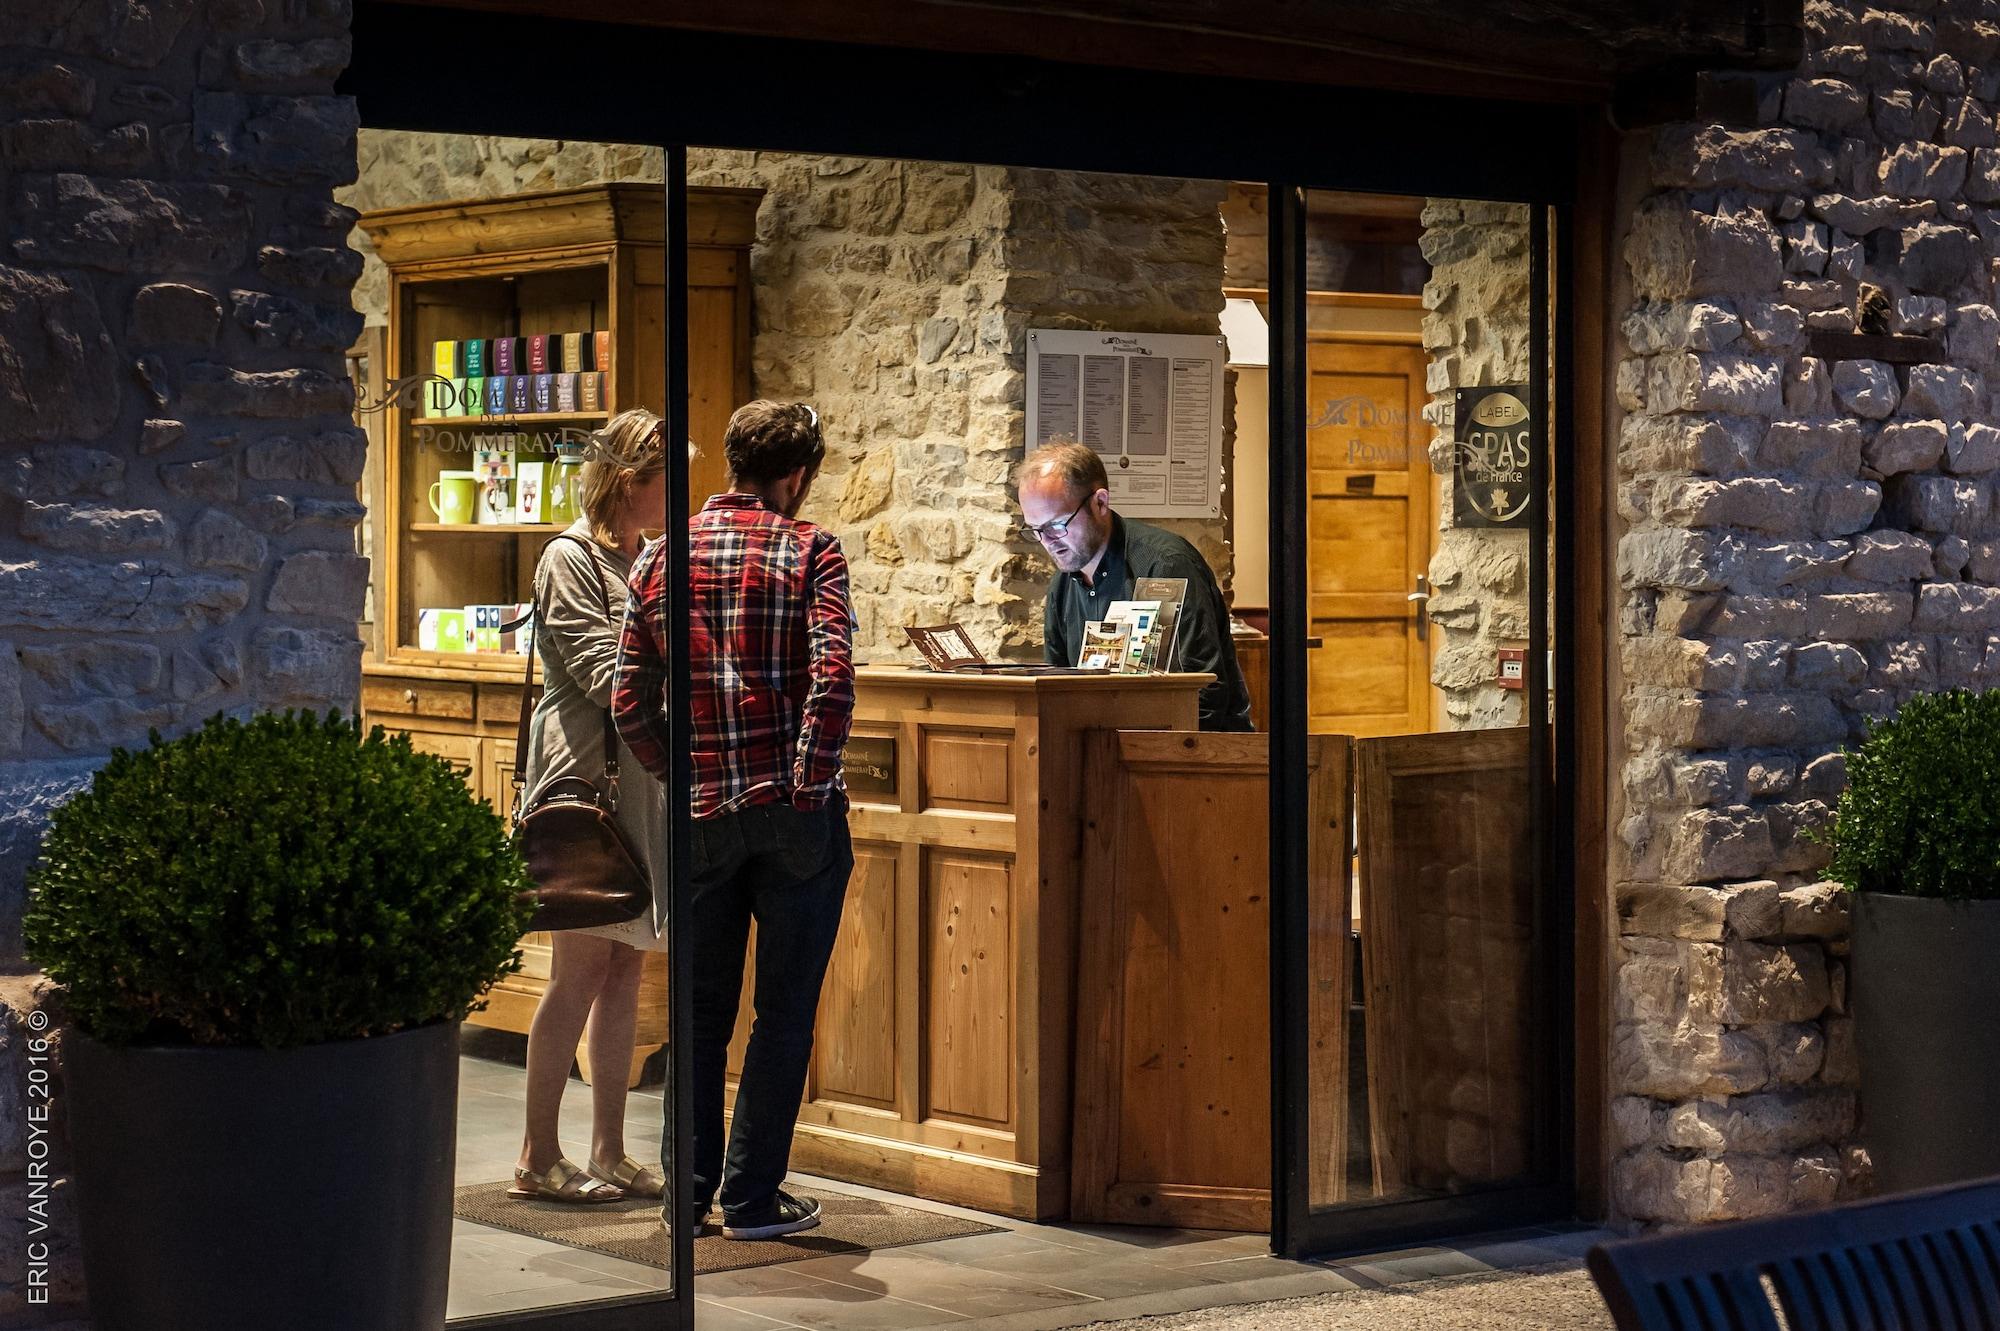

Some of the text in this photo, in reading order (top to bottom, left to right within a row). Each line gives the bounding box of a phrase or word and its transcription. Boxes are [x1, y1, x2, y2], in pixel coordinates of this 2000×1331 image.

[432, 381, 561, 411] DOMINE
[1479, 406, 1520, 418] LABEL
[1469, 430, 1531, 468] SPAS
[1490, 471, 1523, 483] France
